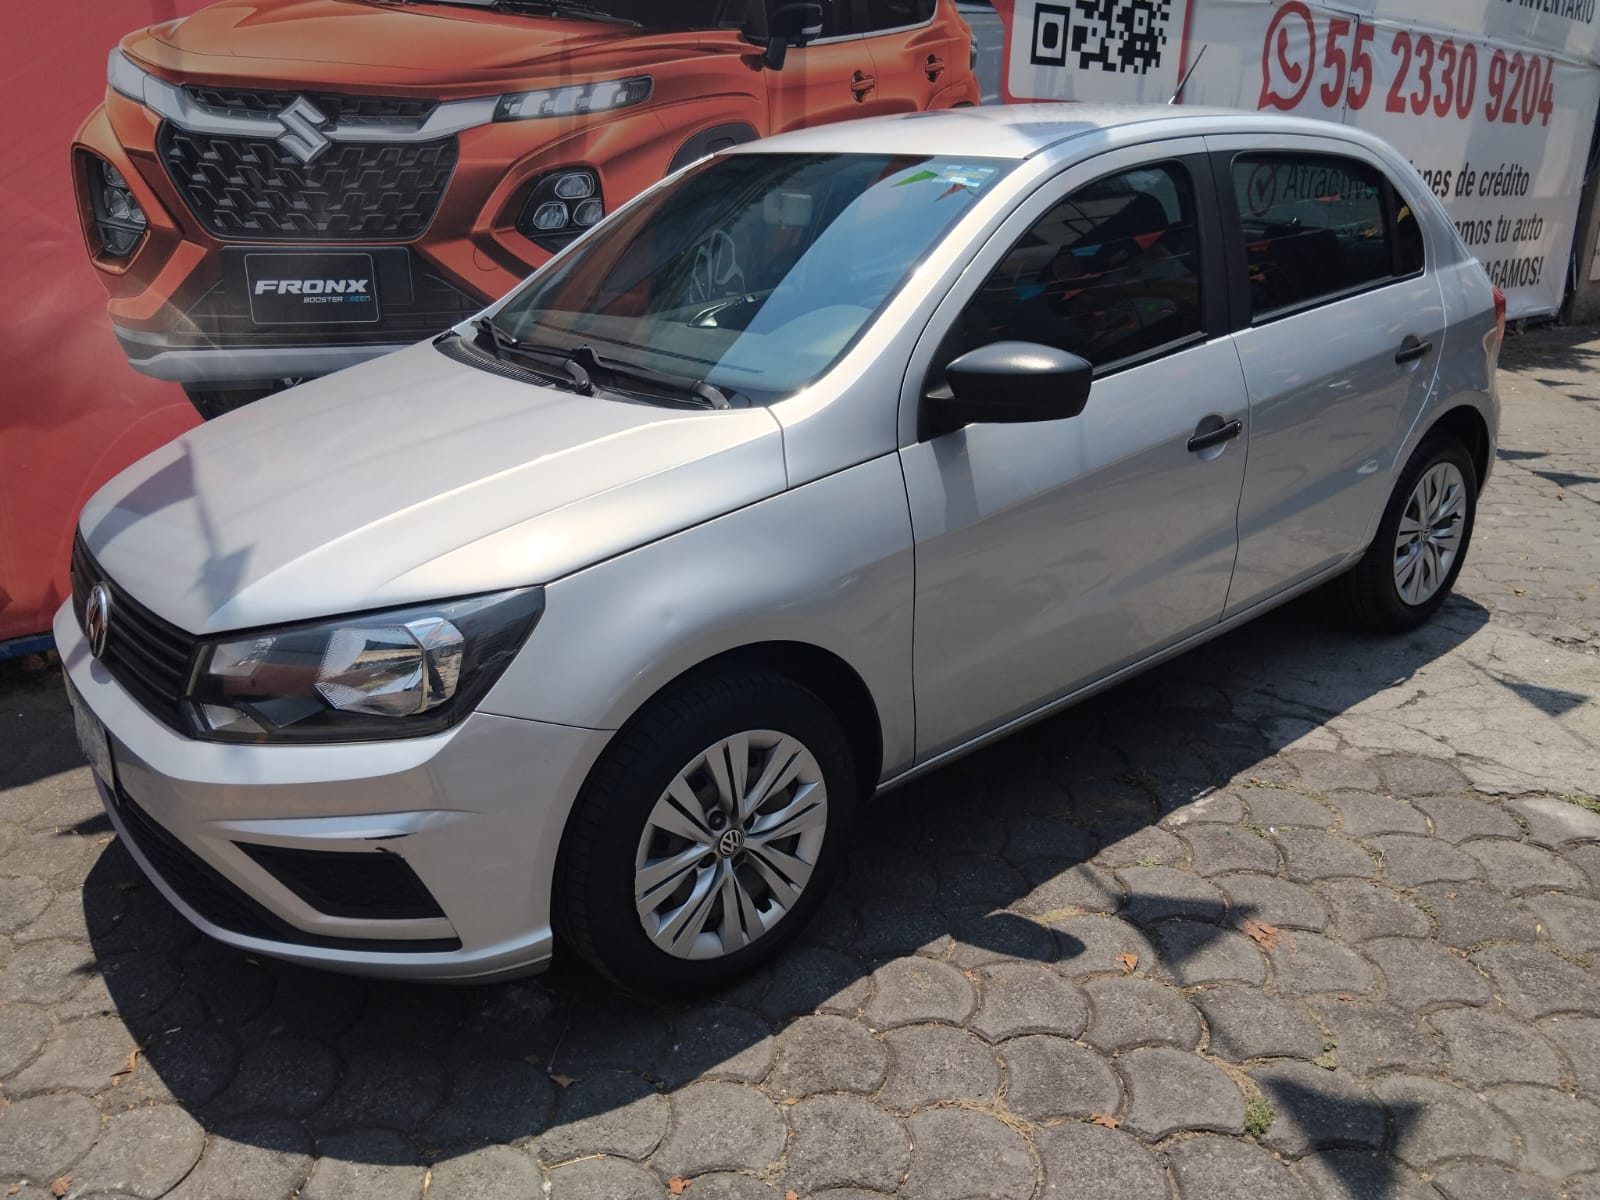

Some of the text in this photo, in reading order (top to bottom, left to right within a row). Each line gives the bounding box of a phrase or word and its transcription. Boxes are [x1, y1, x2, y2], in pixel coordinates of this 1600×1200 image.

[1320, 18, 1555, 127] 55 2330 9204
[1455, 162, 1476, 197] de
[1478, 163, 1530, 197] crédito
[1495, 213, 1512, 244] tu
[1512, 213, 1543, 242] auto
[254, 279, 369, 295] FRONX
[303, 295, 344, 304] BOOSTER
